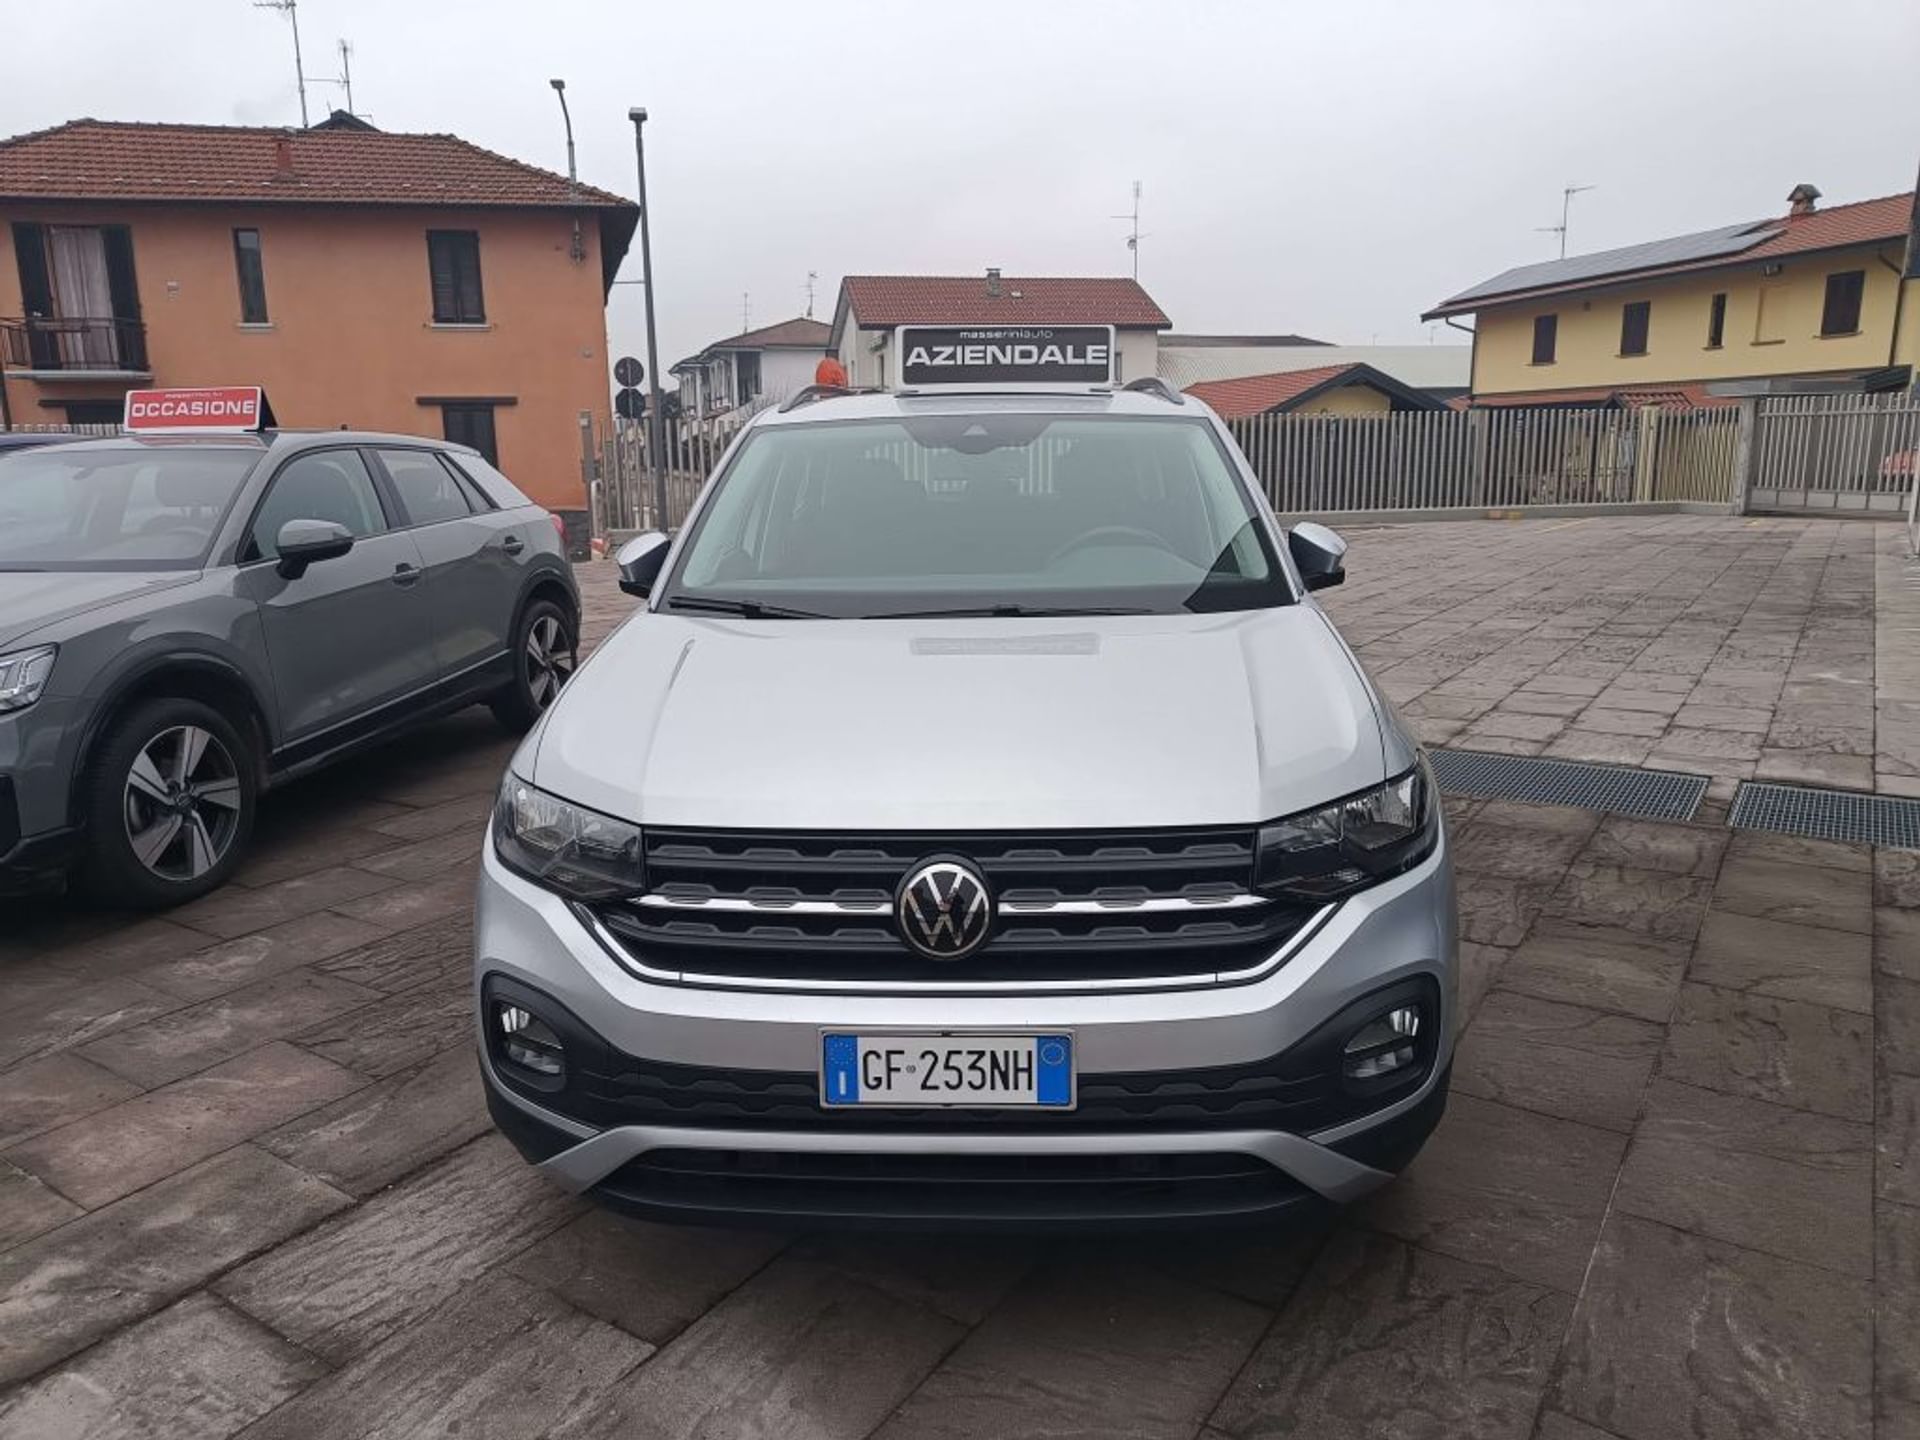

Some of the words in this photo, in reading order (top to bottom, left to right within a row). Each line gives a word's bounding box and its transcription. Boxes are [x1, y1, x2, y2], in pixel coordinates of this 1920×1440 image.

[905, 345, 1108, 366] AZIENDALE
[131, 400, 255, 417] OCCASIONE
[862, 1050, 905, 1091] GF
[919, 1050, 1033, 1091] 253NH
